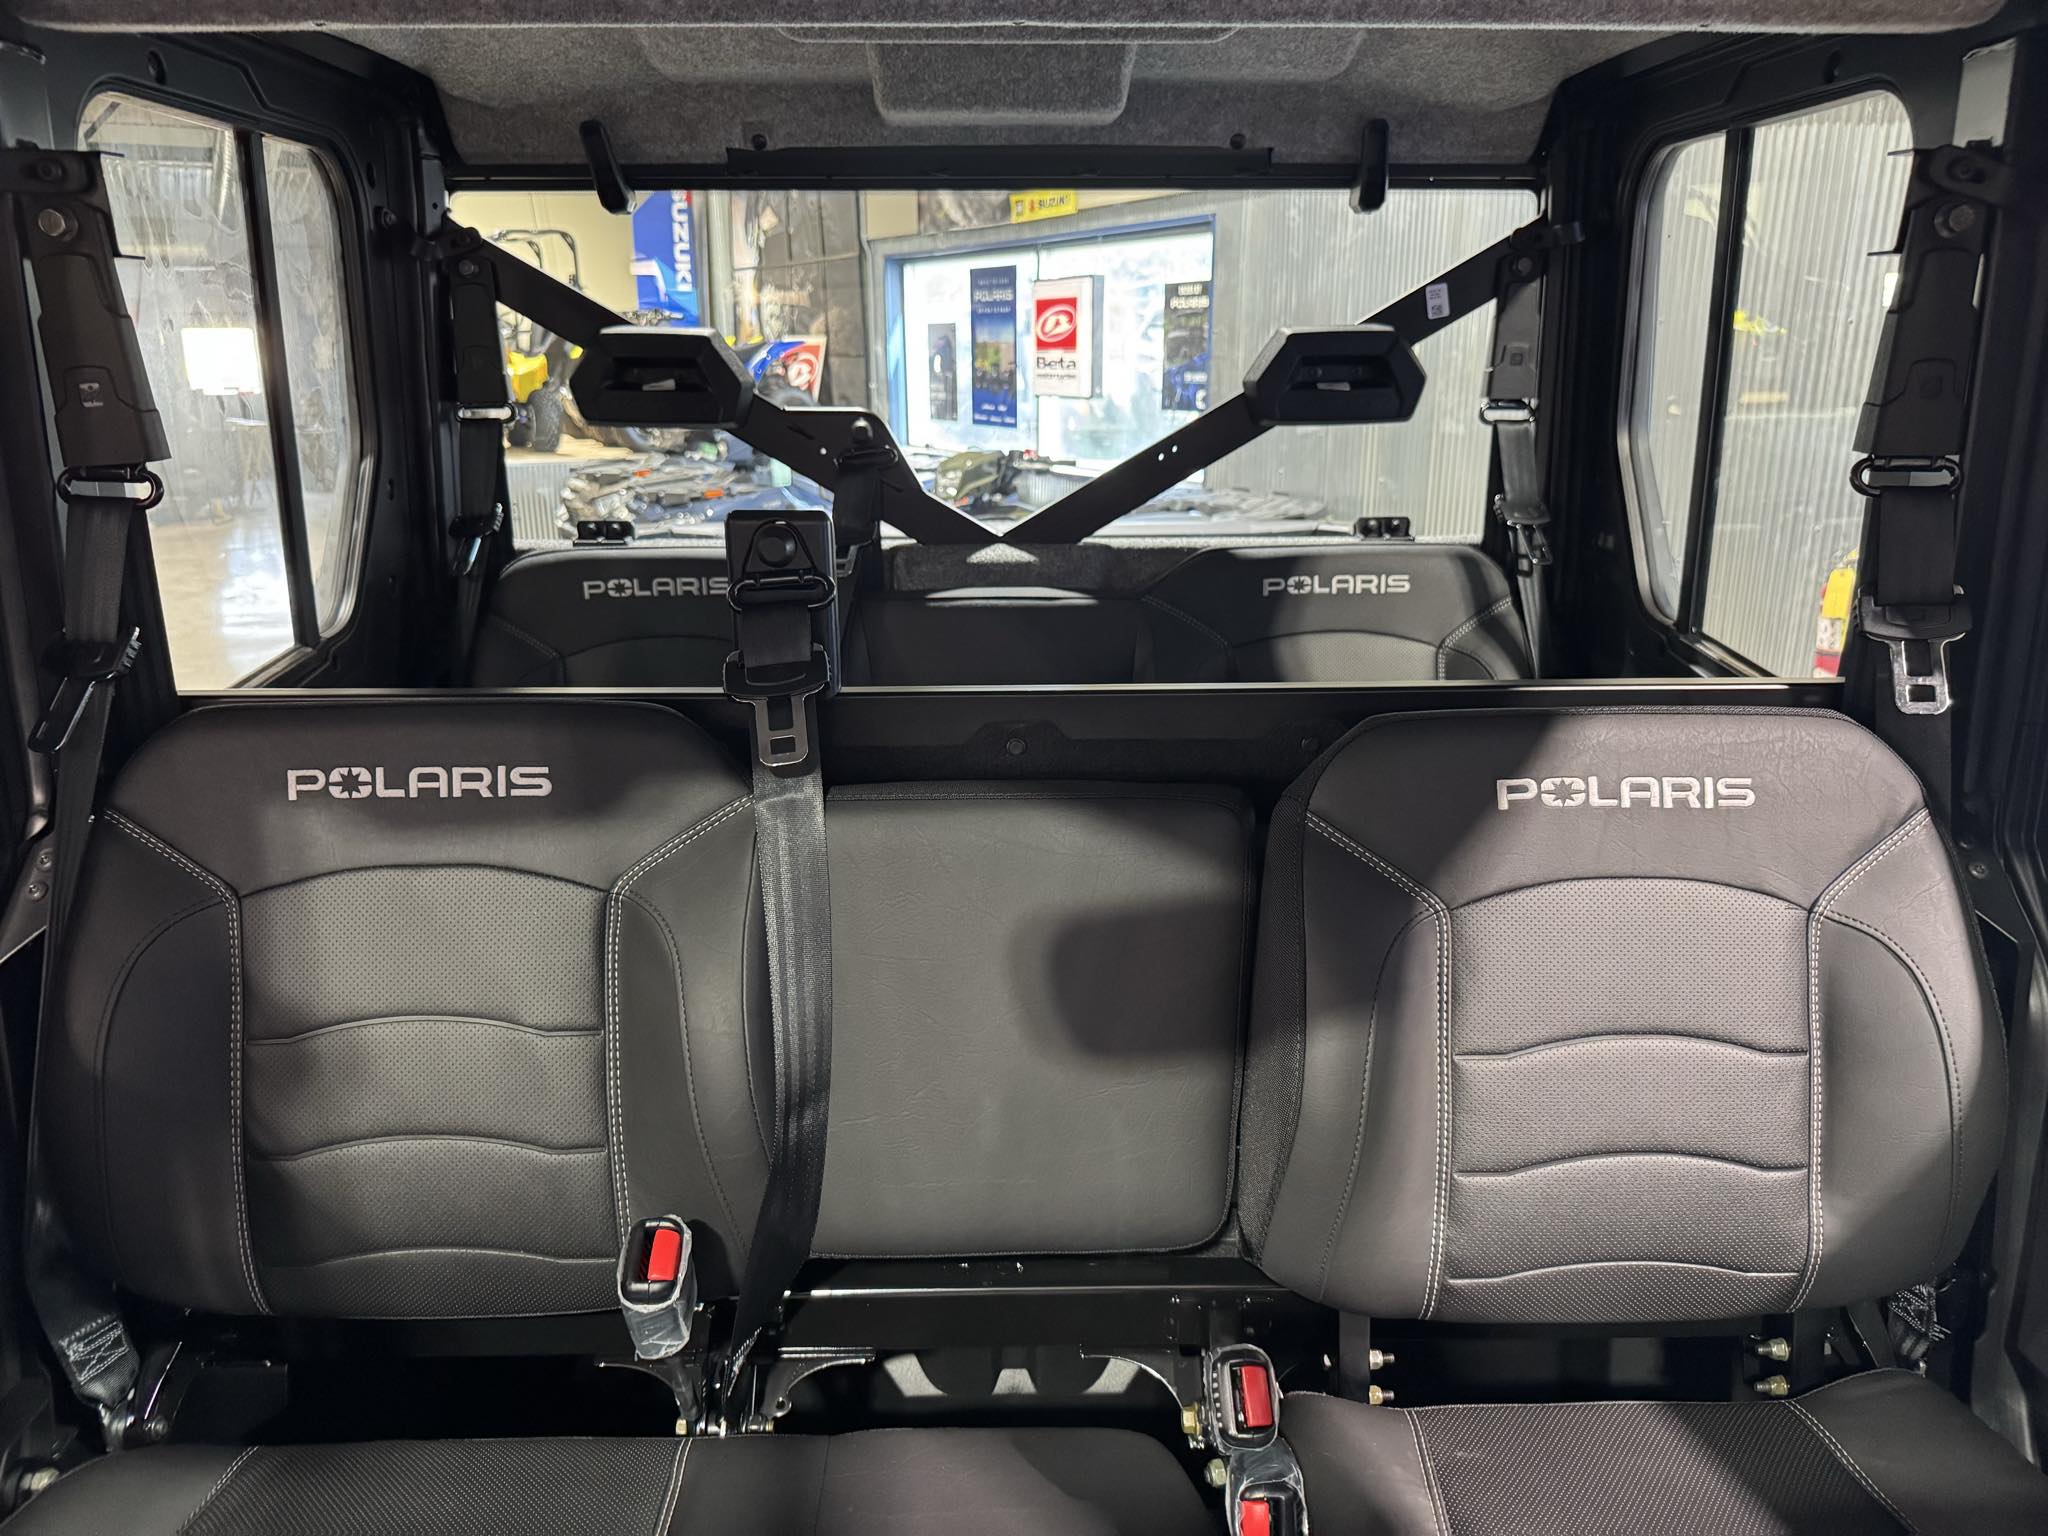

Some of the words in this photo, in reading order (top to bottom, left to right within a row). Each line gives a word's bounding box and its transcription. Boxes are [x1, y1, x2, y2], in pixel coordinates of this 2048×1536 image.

[671, 190, 693, 292] SUZUKI
[1036, 356, 1076, 369] Beta
[583, 577, 729, 600] POLARIS
[1262, 574, 1411, 597] POLARIS
[286, 765, 553, 801] POLARIS
[1496, 776, 1756, 810] POLARIS
